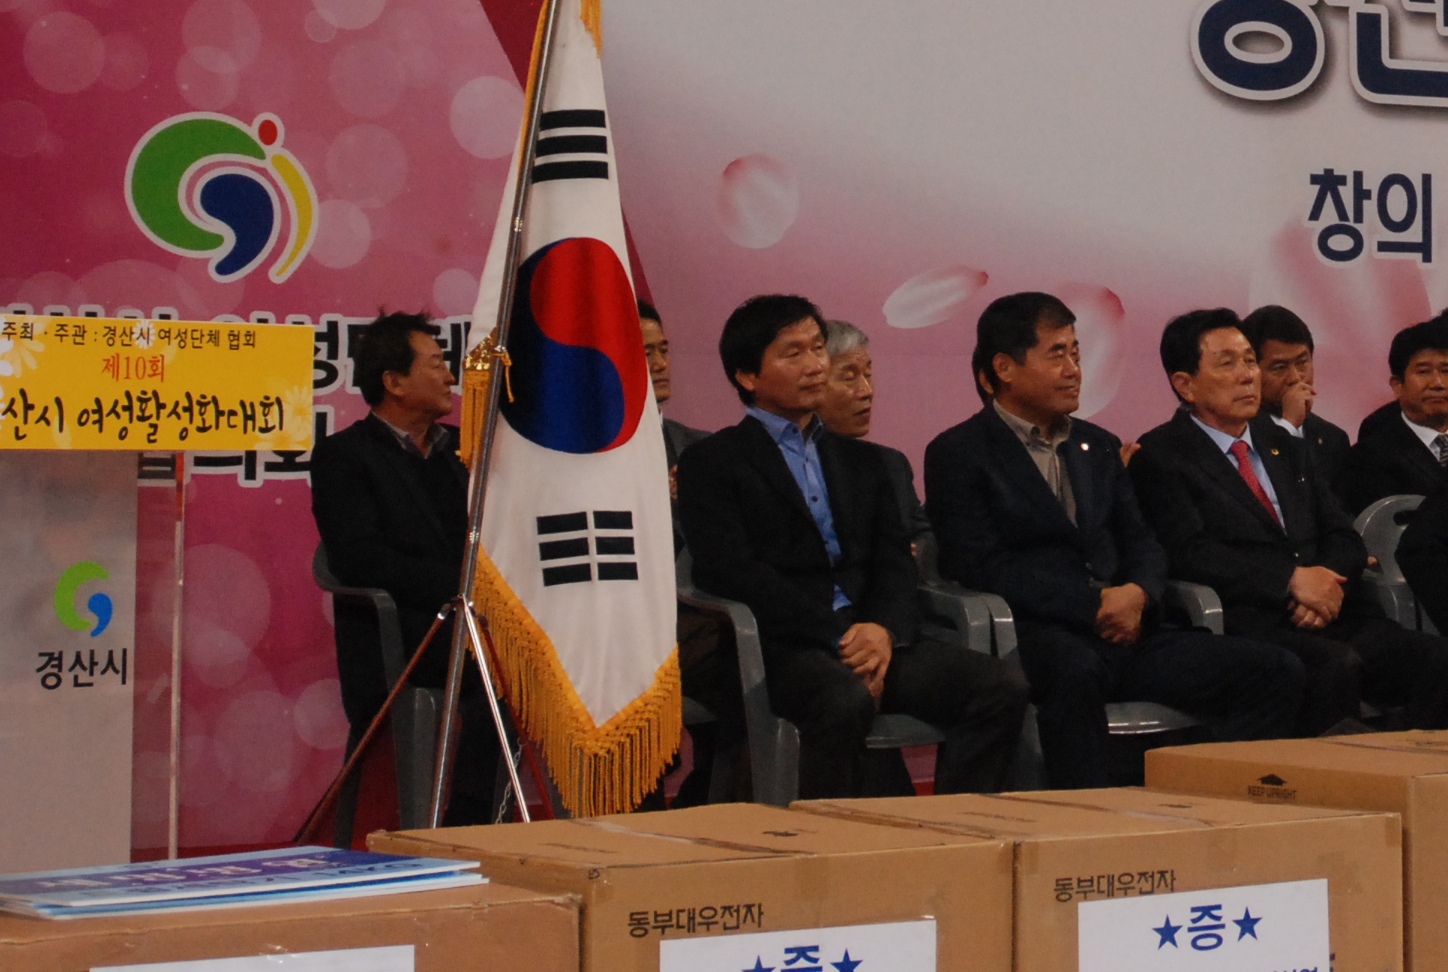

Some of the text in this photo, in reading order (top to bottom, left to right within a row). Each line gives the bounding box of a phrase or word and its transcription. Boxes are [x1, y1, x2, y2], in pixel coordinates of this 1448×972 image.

[1308, 169, 1432, 265] 창의
[1, 321, 256, 349] 주최 주관 경산시 여성단체 협회
[101, 353, 165, 382] 제10회
[77, 389, 284, 443] 여성활성화대회
[36, 648, 128, 690] 경산시
[1053, 869, 1176, 903] 동부대우전자
[628, 903, 764, 939] 동부대우전자
[1187, 904, 1226, 951] 증
